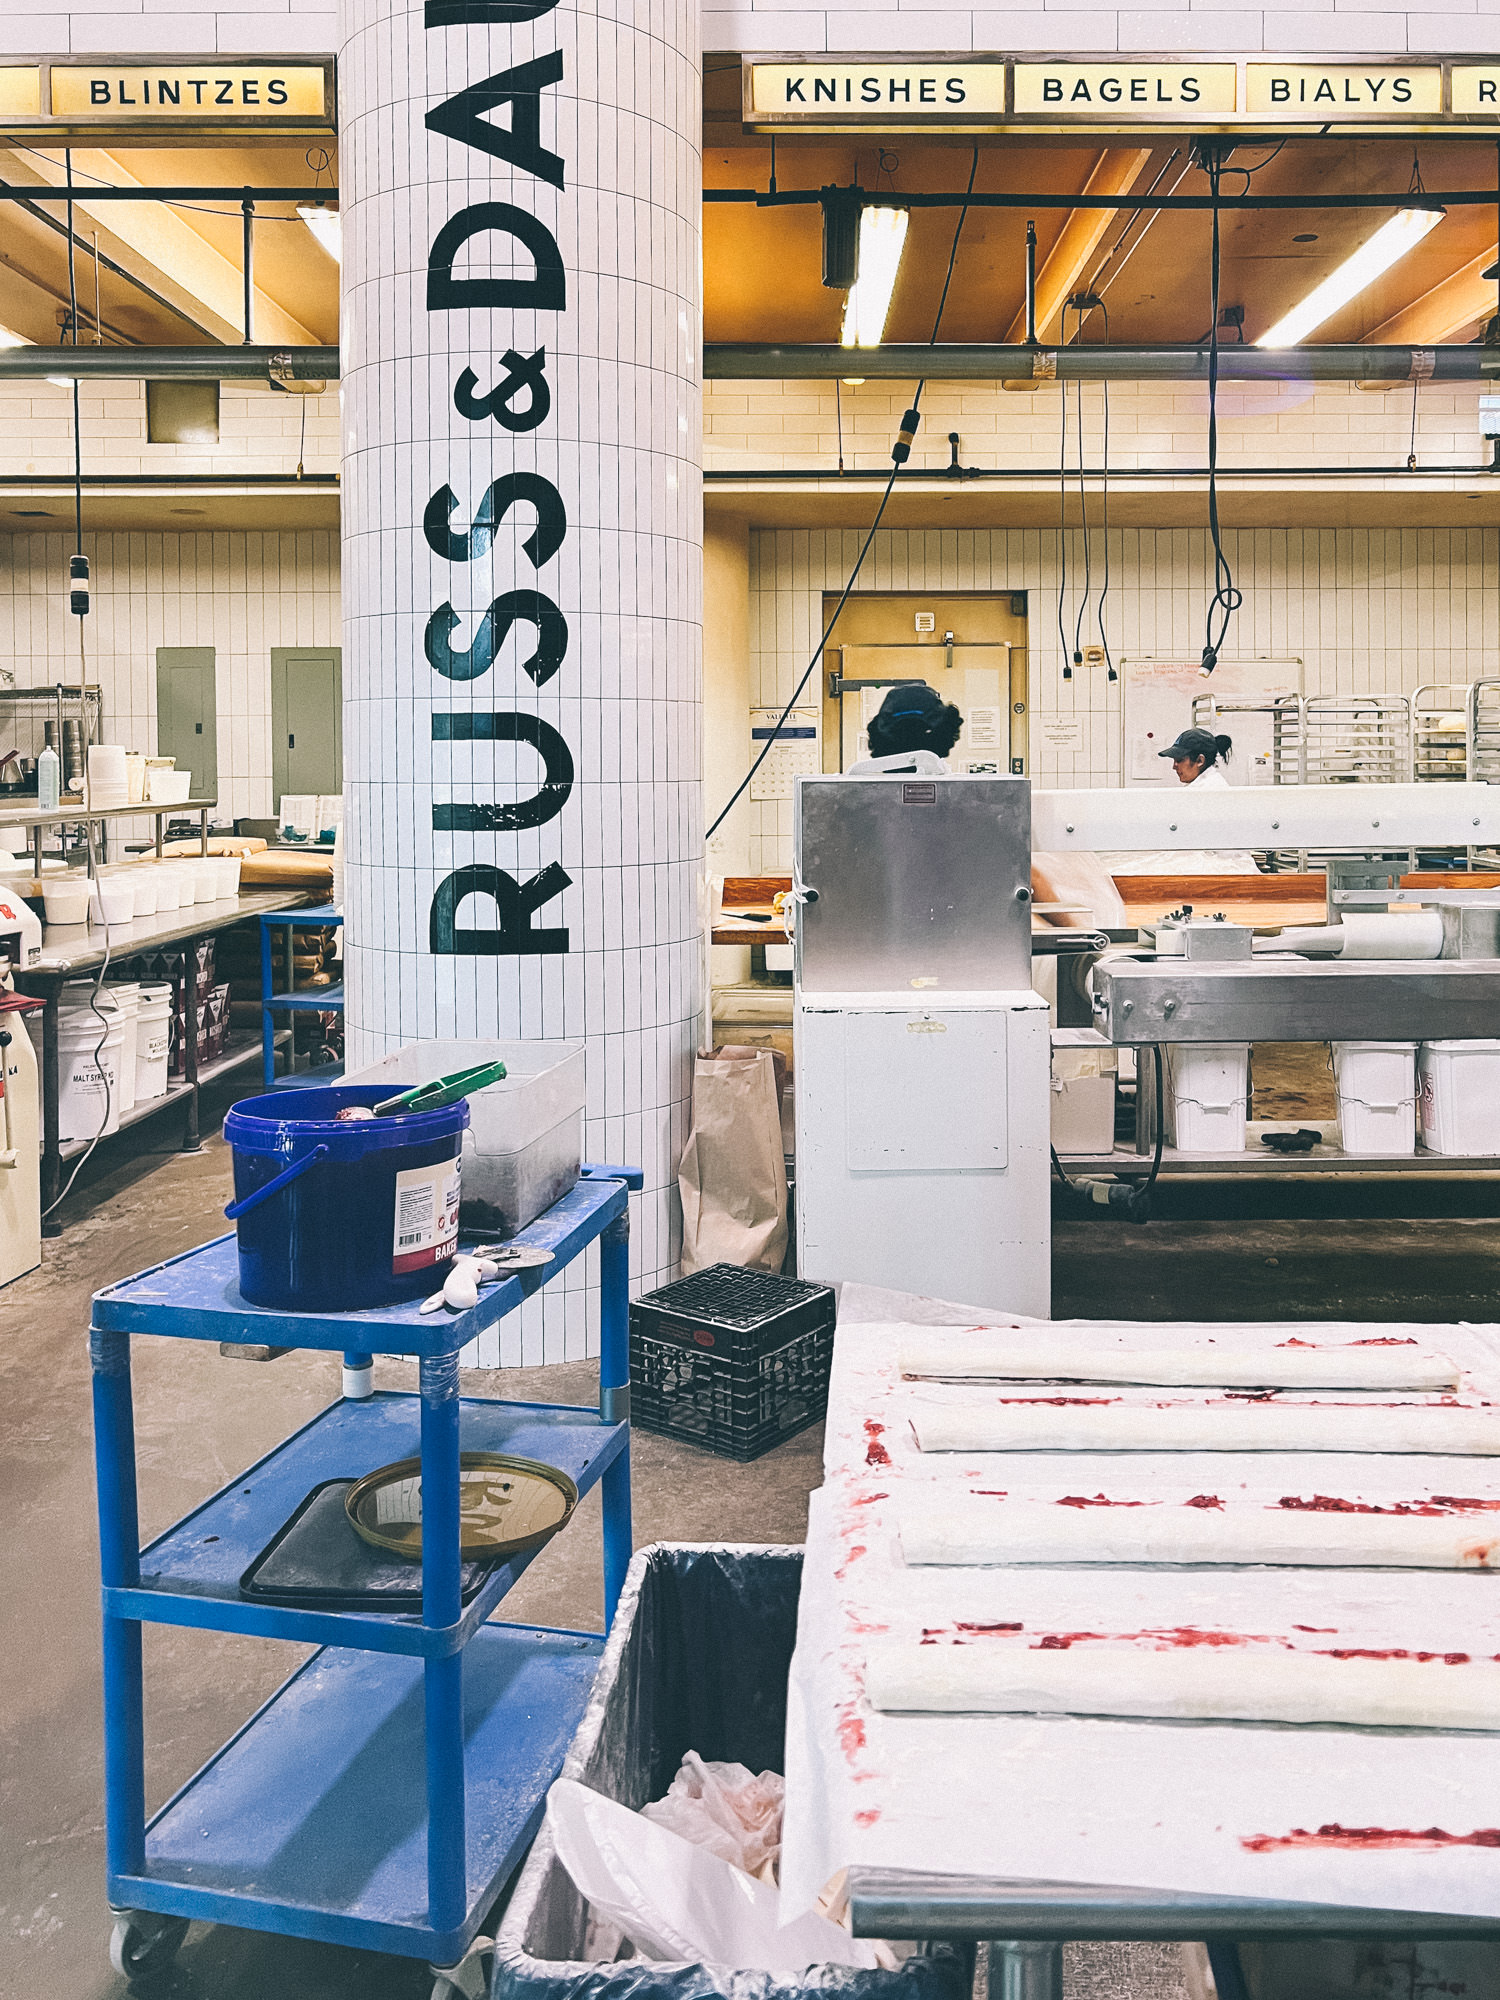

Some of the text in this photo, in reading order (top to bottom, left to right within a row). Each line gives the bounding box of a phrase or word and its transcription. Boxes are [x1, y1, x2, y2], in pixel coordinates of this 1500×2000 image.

[90, 80, 288, 105] BLINTZES
[786, 77, 967, 103] KNISHES
[1043, 77, 1201, 103] BAGELS
[1271, 77, 1412, 103] BIALYS
[424, 0, 574, 956] RUSS & DA
[73, 1073, 90, 1082] MALT
